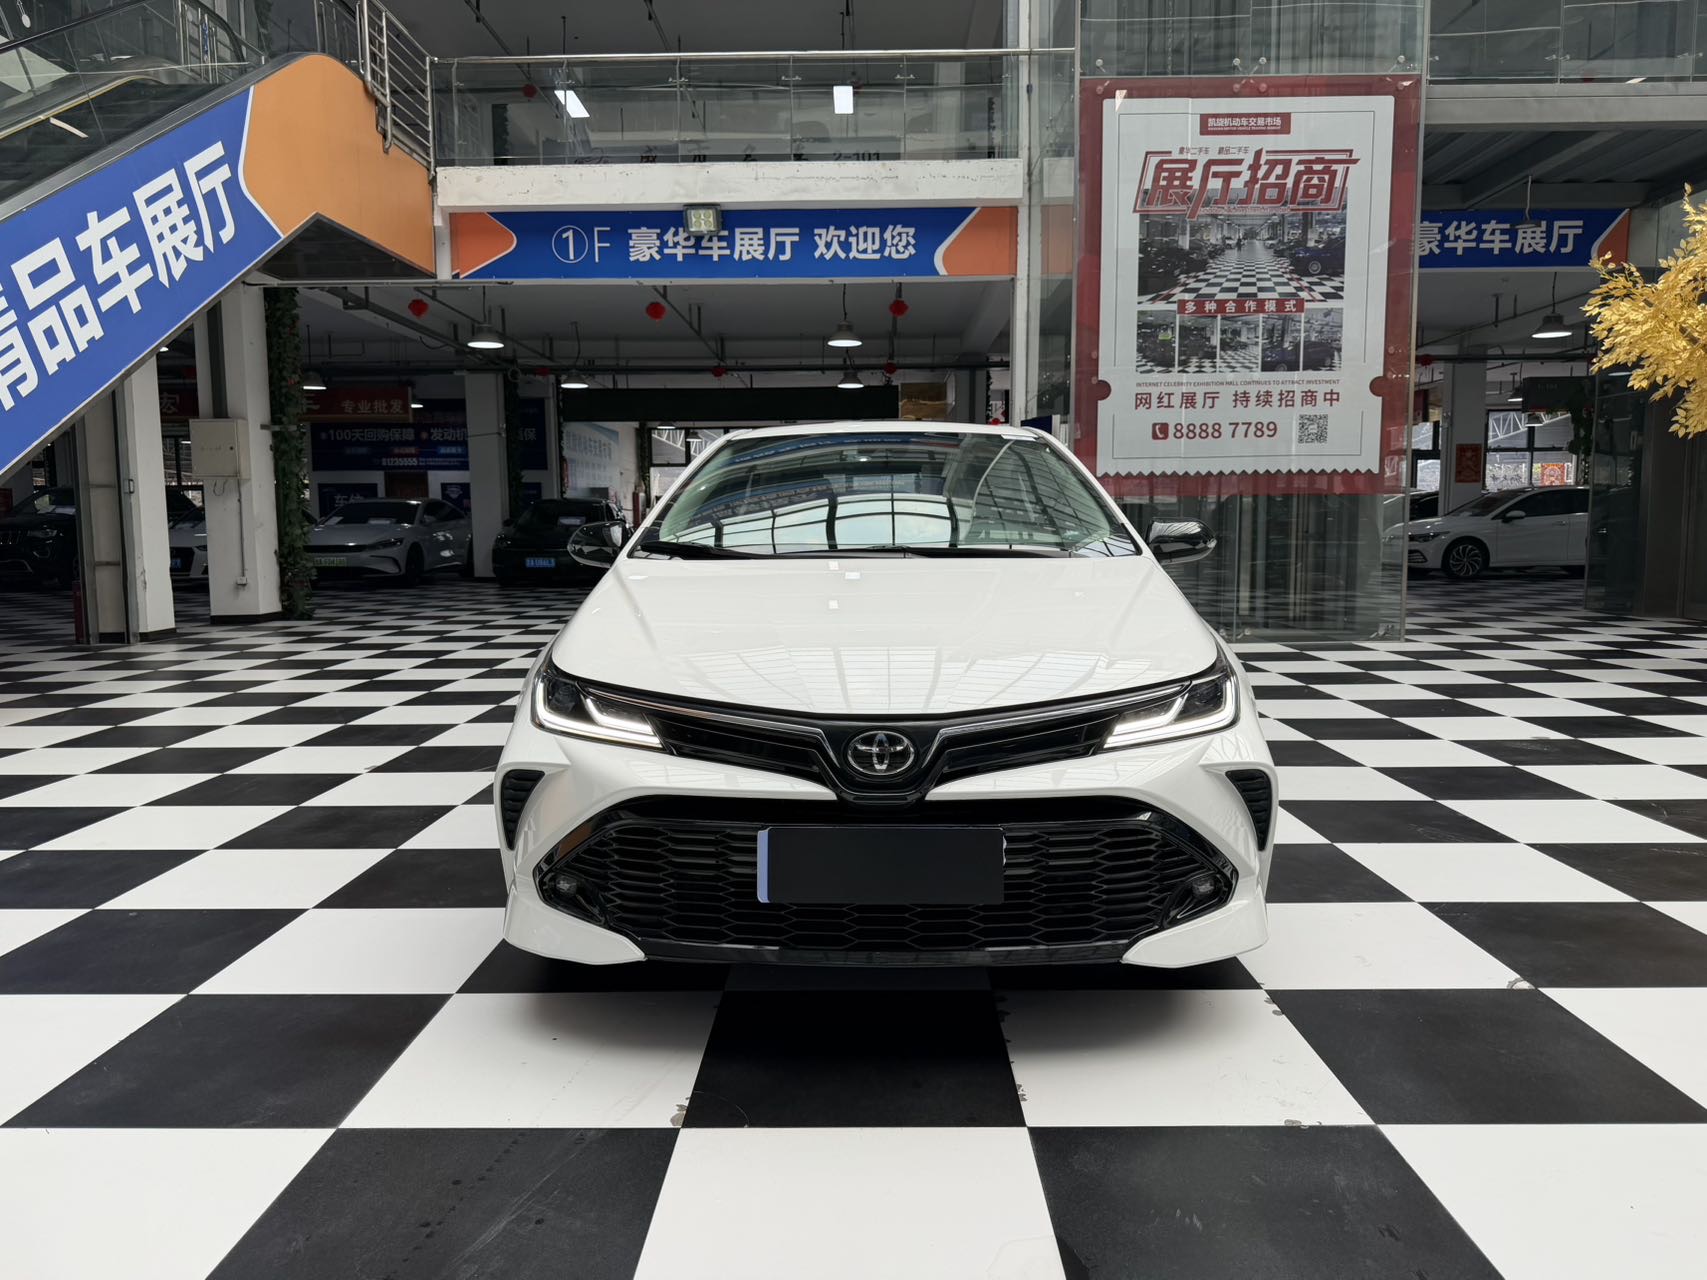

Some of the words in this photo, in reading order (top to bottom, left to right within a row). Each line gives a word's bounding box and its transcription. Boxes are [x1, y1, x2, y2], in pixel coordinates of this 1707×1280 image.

[1146, 147, 1361, 220] 展厅招商
[627, 227, 800, 262] 豪华车展厅
[813, 225, 917, 261] 欢迎您
[1418, 219, 1584, 254] 豪华车展厅
[1184, 300, 1297, 314] 多种合作模式
[341, 400, 404, 414] 专业批发
[1135, 391, 1220, 410] 网红展厅
[1233, 389, 1340, 409] 持续招商中
[1173, 422, 1222, 440] 8888
[1228, 421, 1278, 439] 7789
